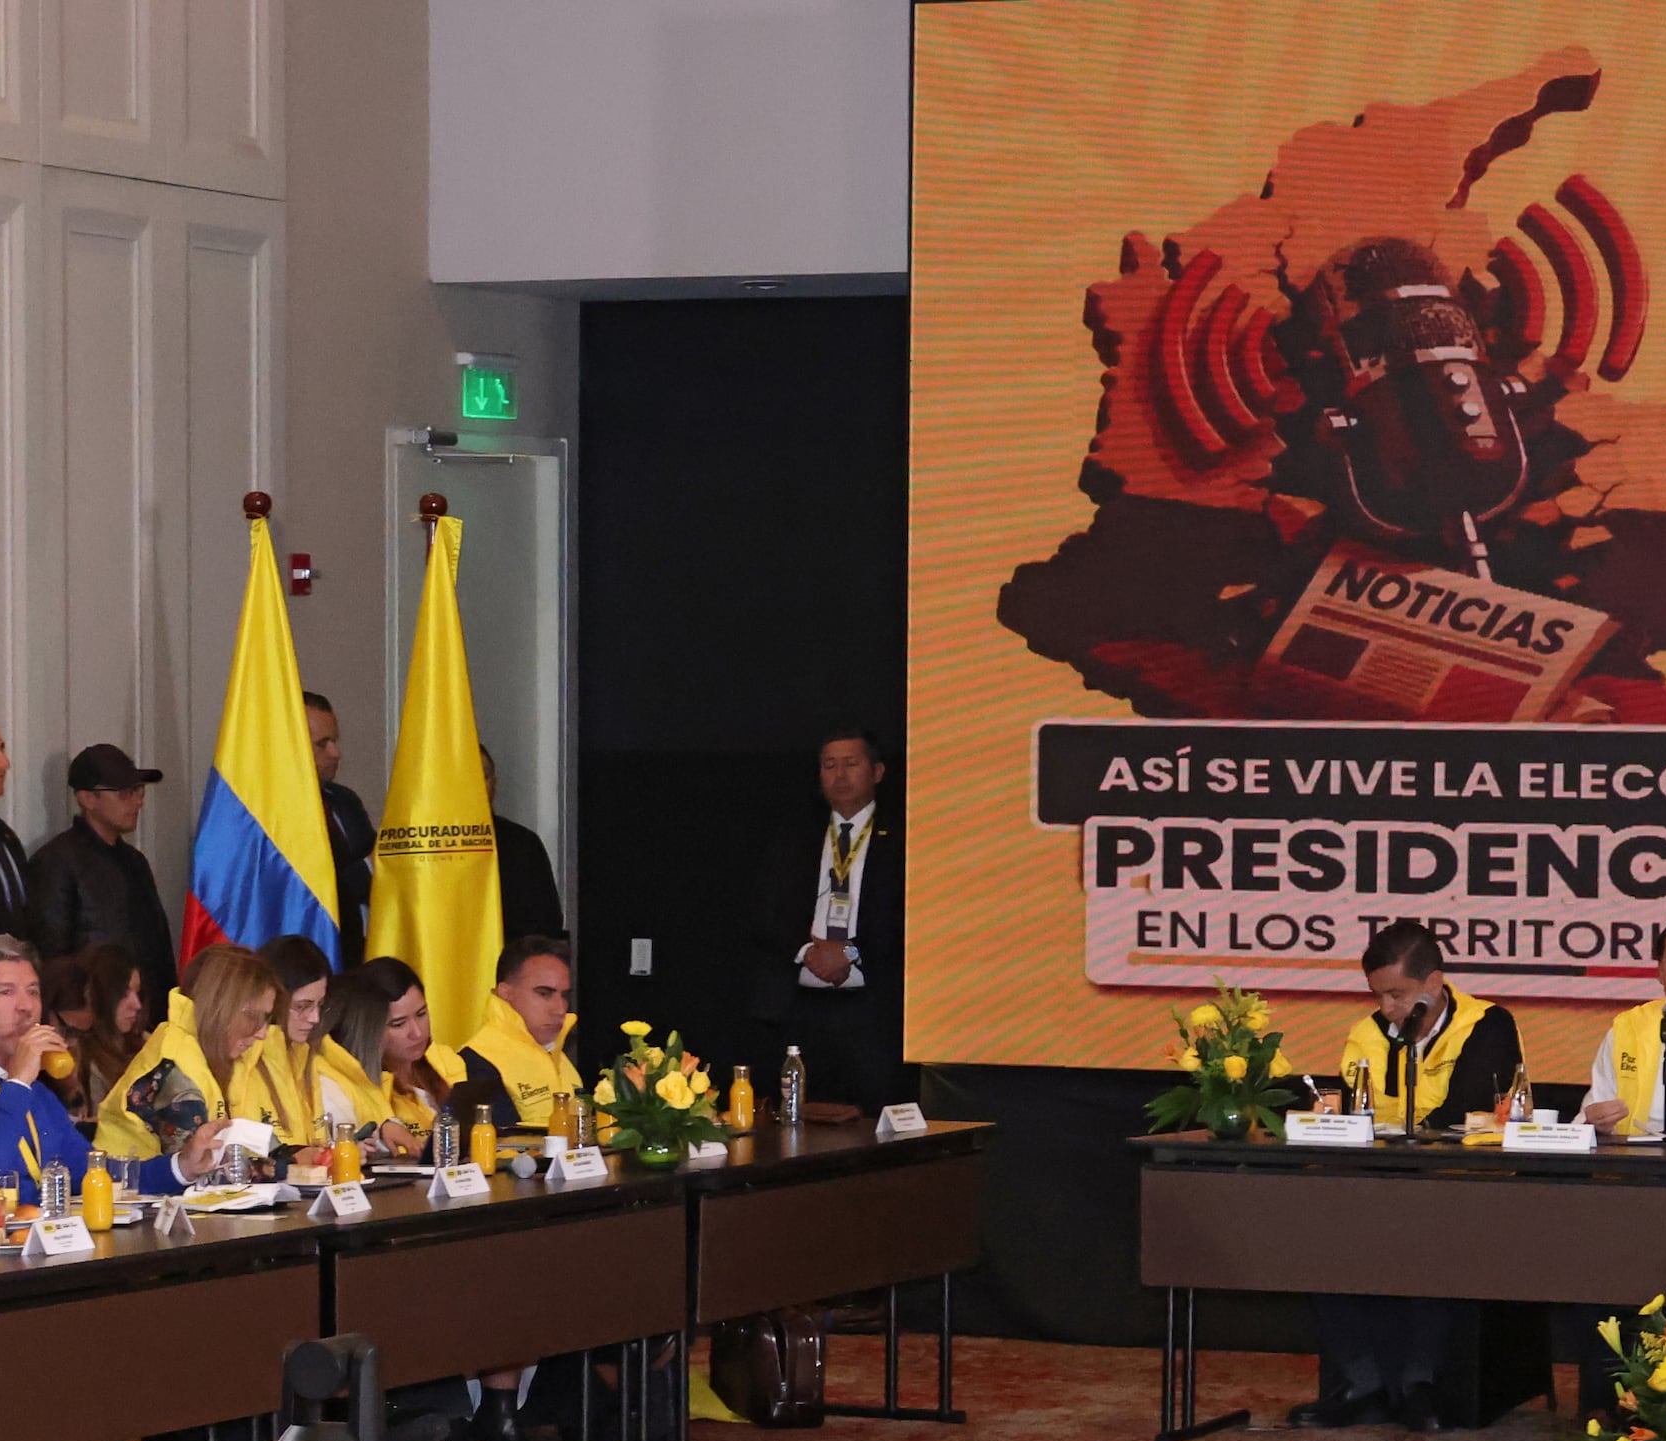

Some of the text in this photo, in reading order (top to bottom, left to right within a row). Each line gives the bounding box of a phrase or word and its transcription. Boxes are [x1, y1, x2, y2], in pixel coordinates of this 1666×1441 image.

[1325, 562, 1575, 655] NOTICIAS
[1099, 747, 1191, 793] ASÍ
[1207, 758, 1270, 794] SE
[1285, 759, 1417, 797] VIVE
[1434, 761, 1503, 799] LA
[379, 822, 493, 840] PROCURADURÍA
[379, 840, 424, 851] GENERAL
[428, 839, 442, 848] DE
[1137, 911, 1209, 949] EN
[1229, 912, 1336, 951] LOS
